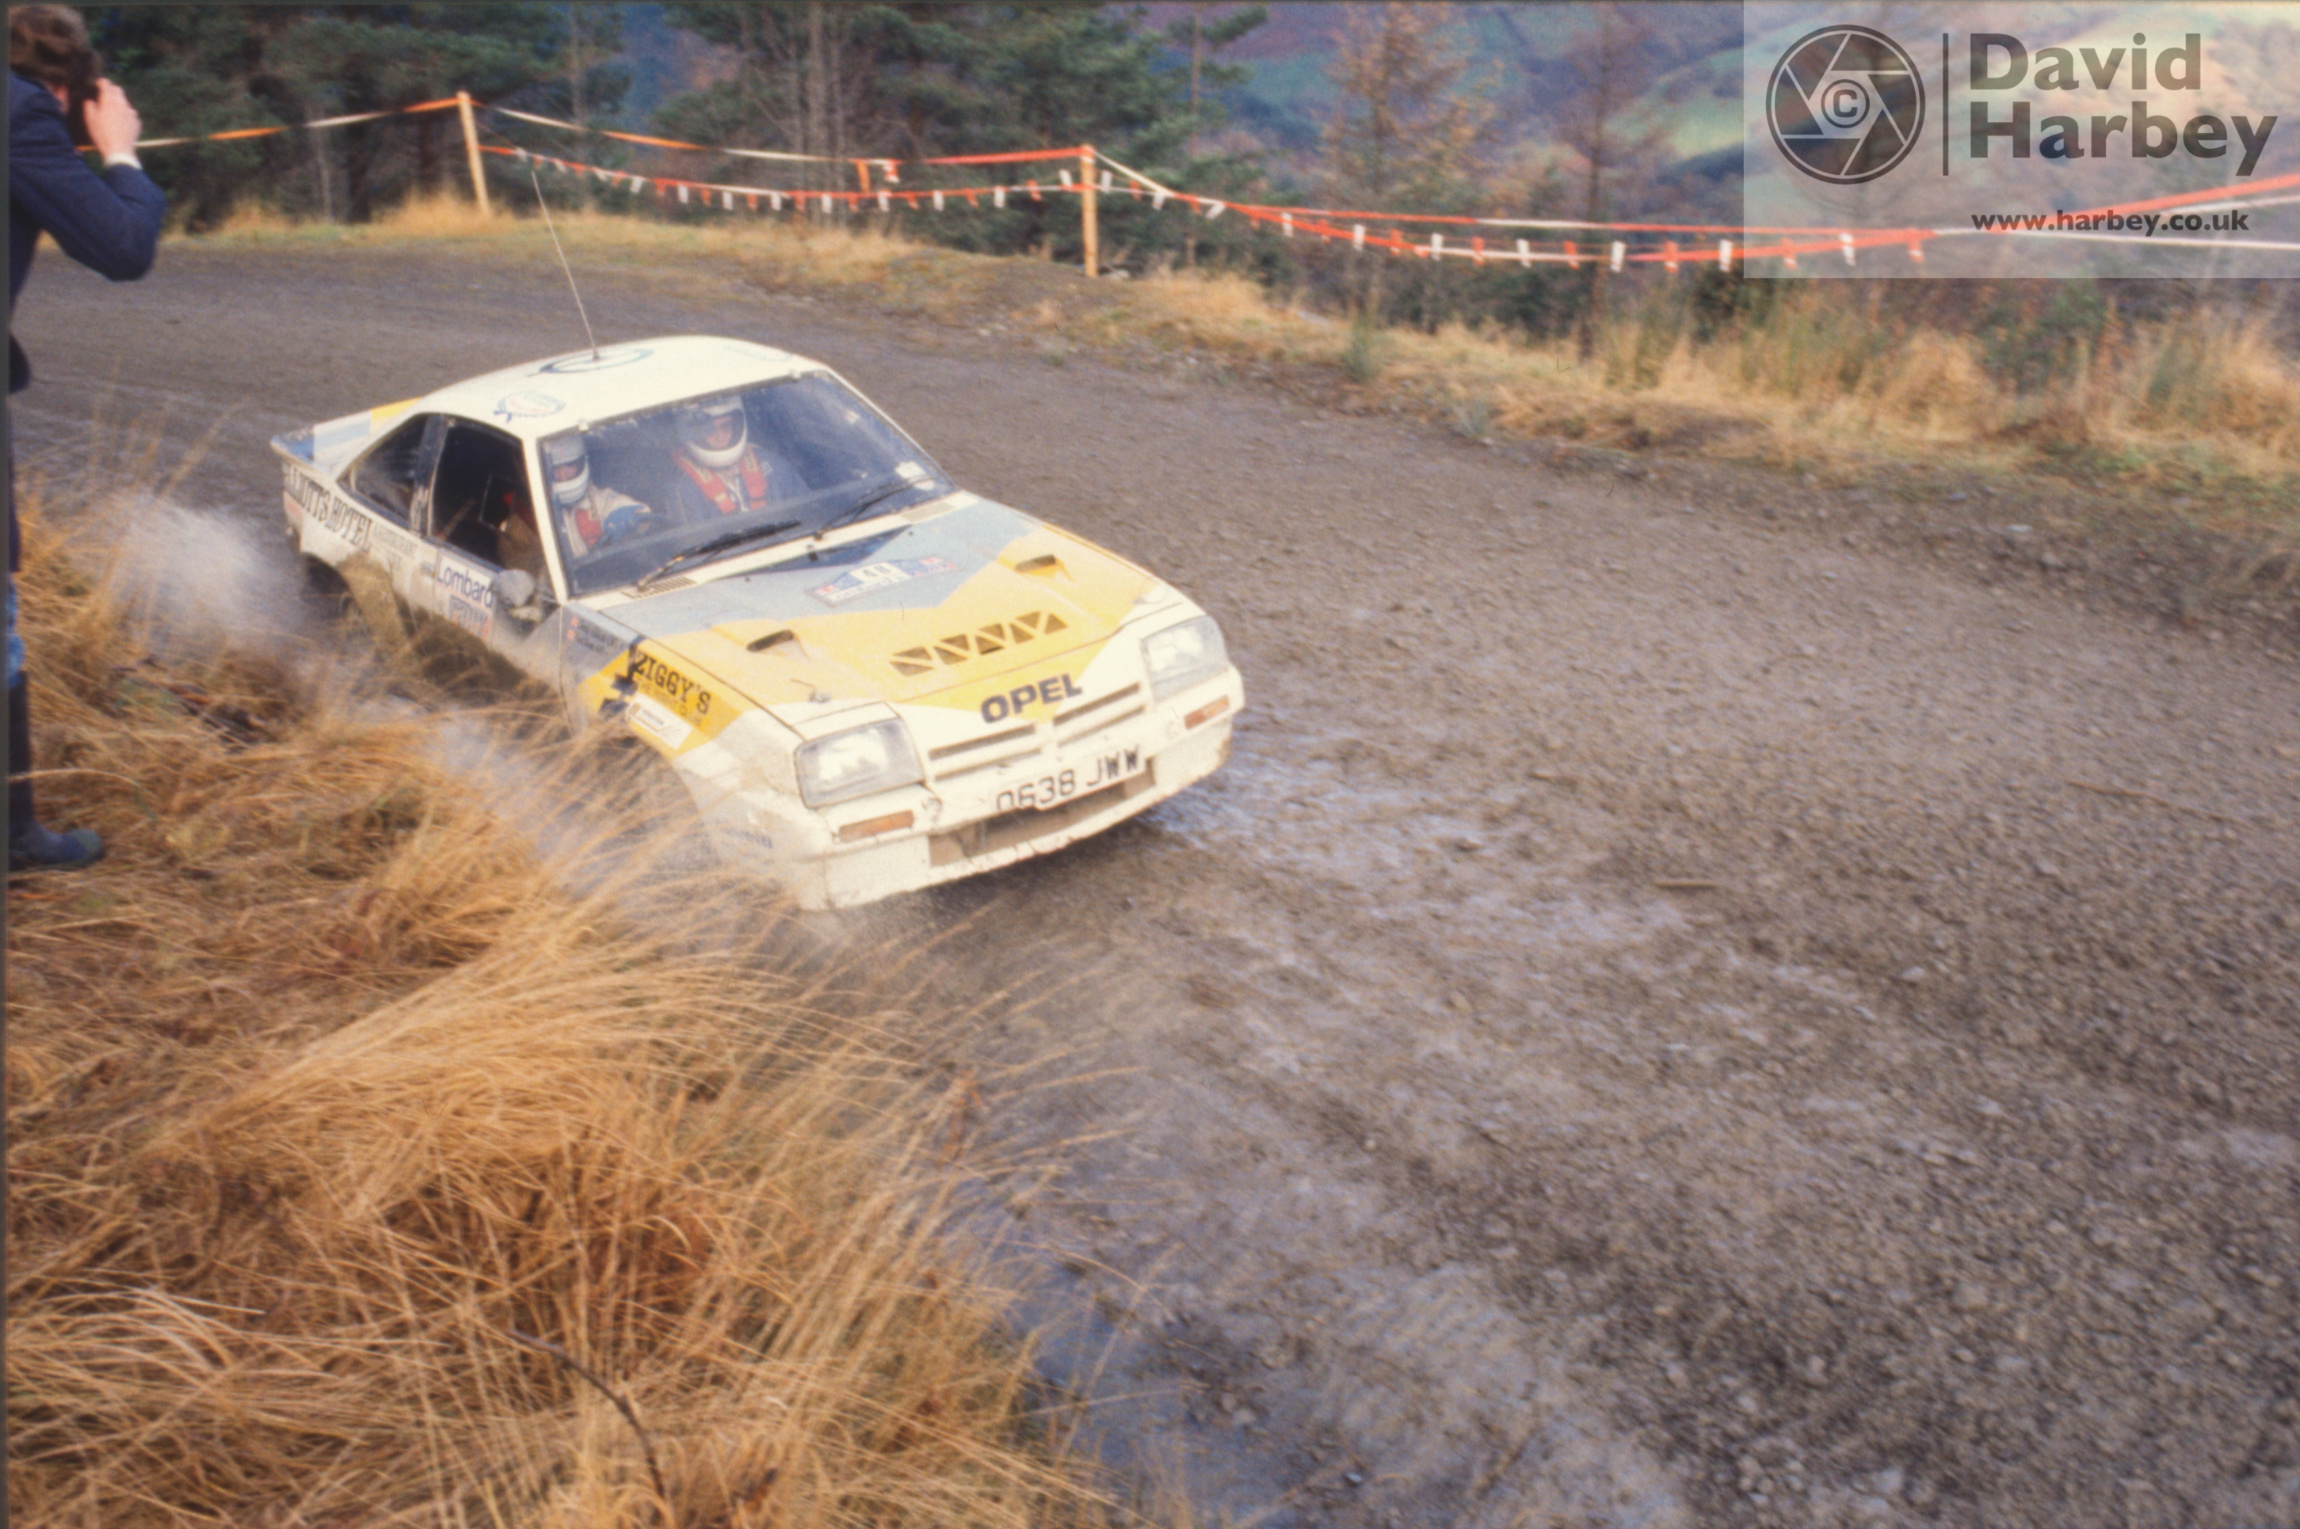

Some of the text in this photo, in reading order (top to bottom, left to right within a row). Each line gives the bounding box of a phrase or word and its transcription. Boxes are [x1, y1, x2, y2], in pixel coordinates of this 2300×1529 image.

[325, 495, 374, 552] HOTEL
[436, 562, 493, 608] Lombard
[635, 652, 712, 716] ZIGGY'S
[980, 673, 1083, 724] OPEL
[1086, 744, 1140, 786] JWW
